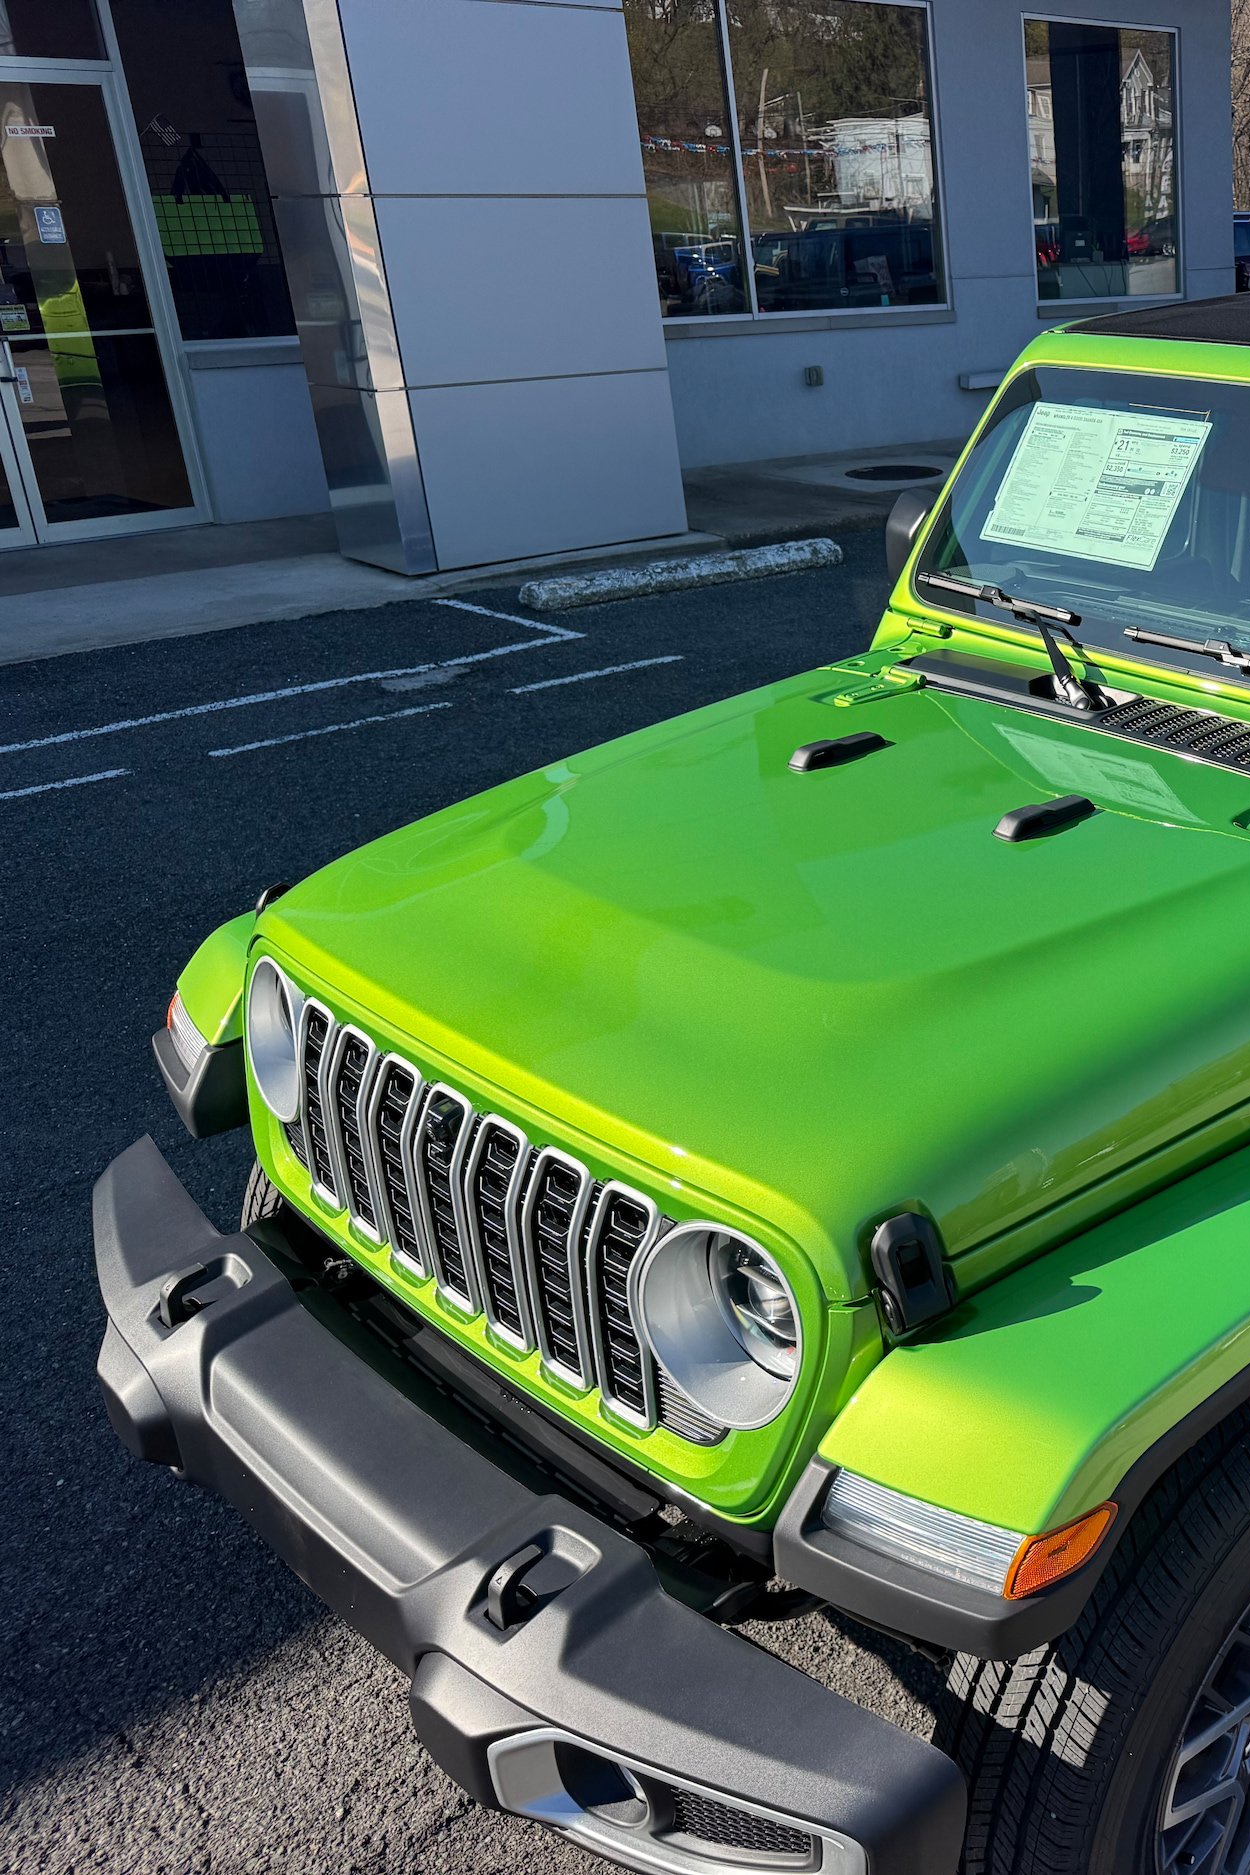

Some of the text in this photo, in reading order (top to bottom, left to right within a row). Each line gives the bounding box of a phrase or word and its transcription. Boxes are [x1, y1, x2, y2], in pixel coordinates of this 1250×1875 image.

[8, 127, 53, 135] NO SMOKING
[1117, 439, 1130, 451] 21
